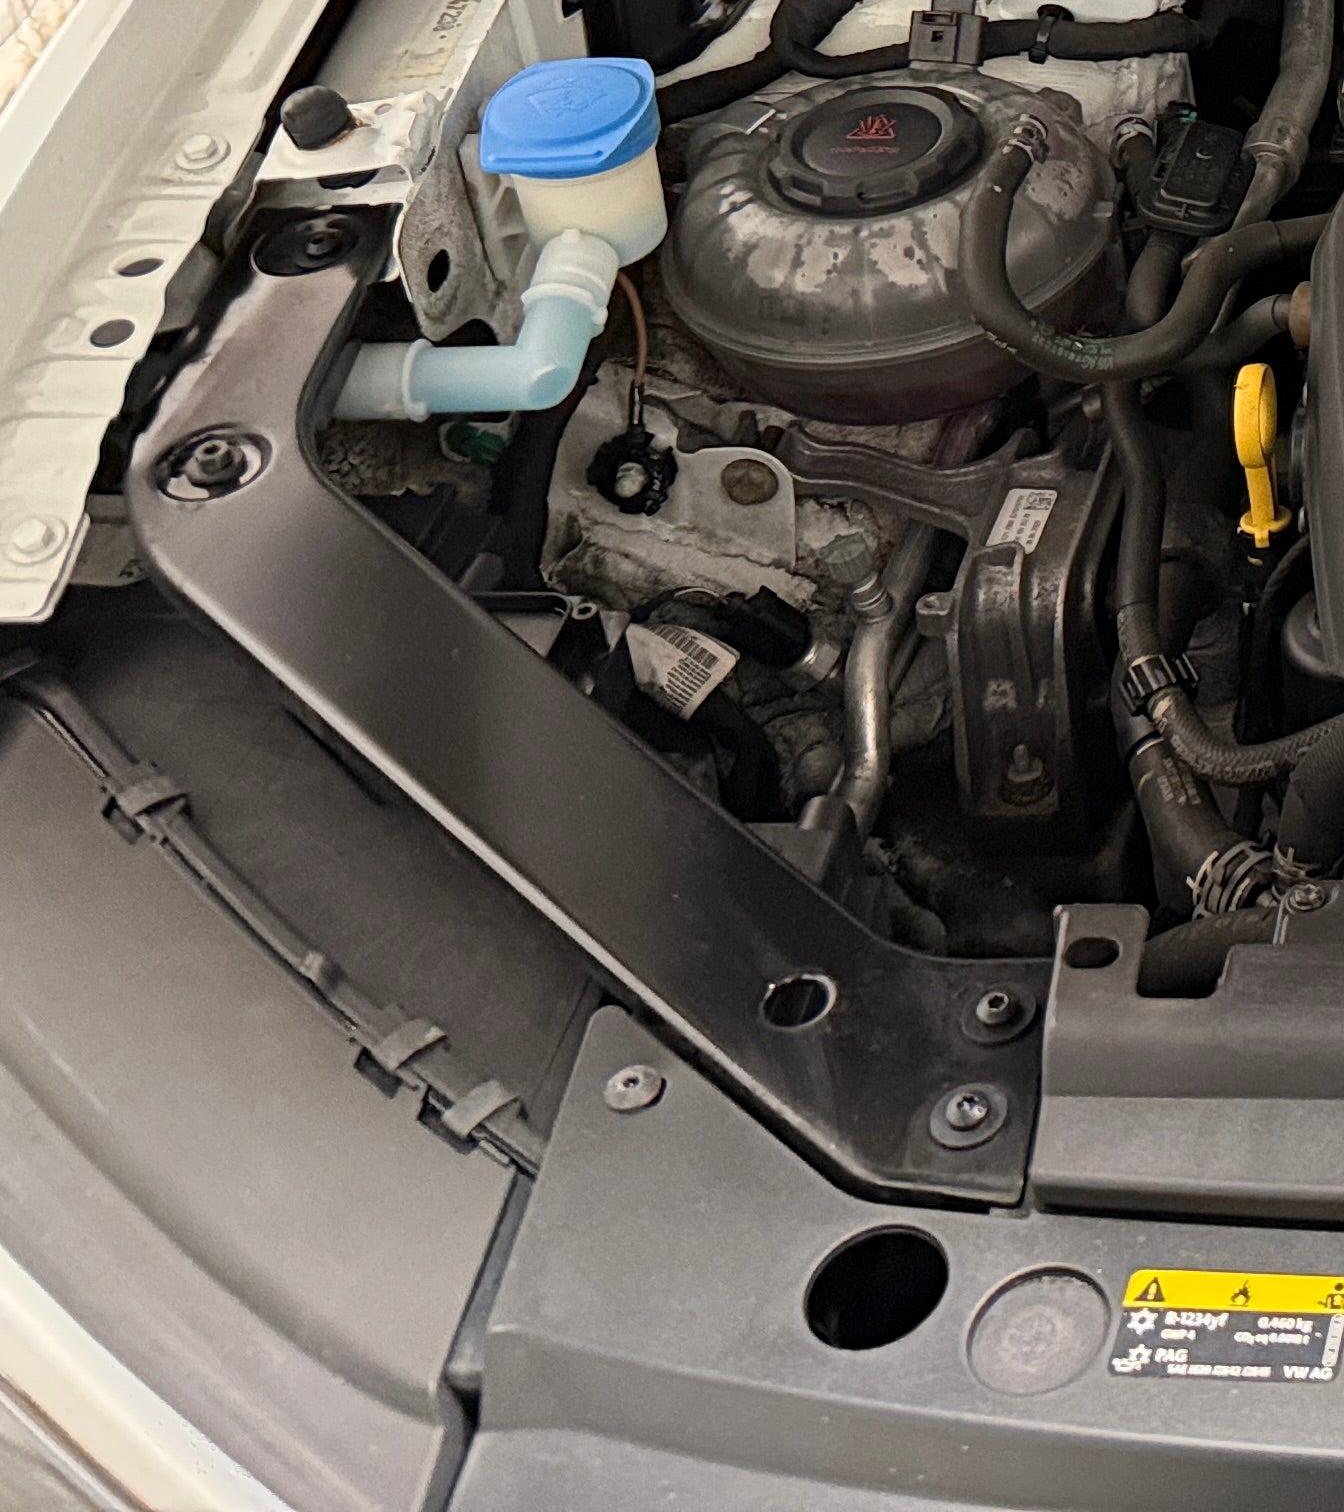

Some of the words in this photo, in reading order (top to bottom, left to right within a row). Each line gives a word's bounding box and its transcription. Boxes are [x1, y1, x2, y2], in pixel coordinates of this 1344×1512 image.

[1164, 1311, 1230, 1331] R-1234yf
[1154, 1347, 1189, 1363] PAG
[1282, 1365, 1309, 1380] VW
[1309, 1366, 1334, 1381] AG
